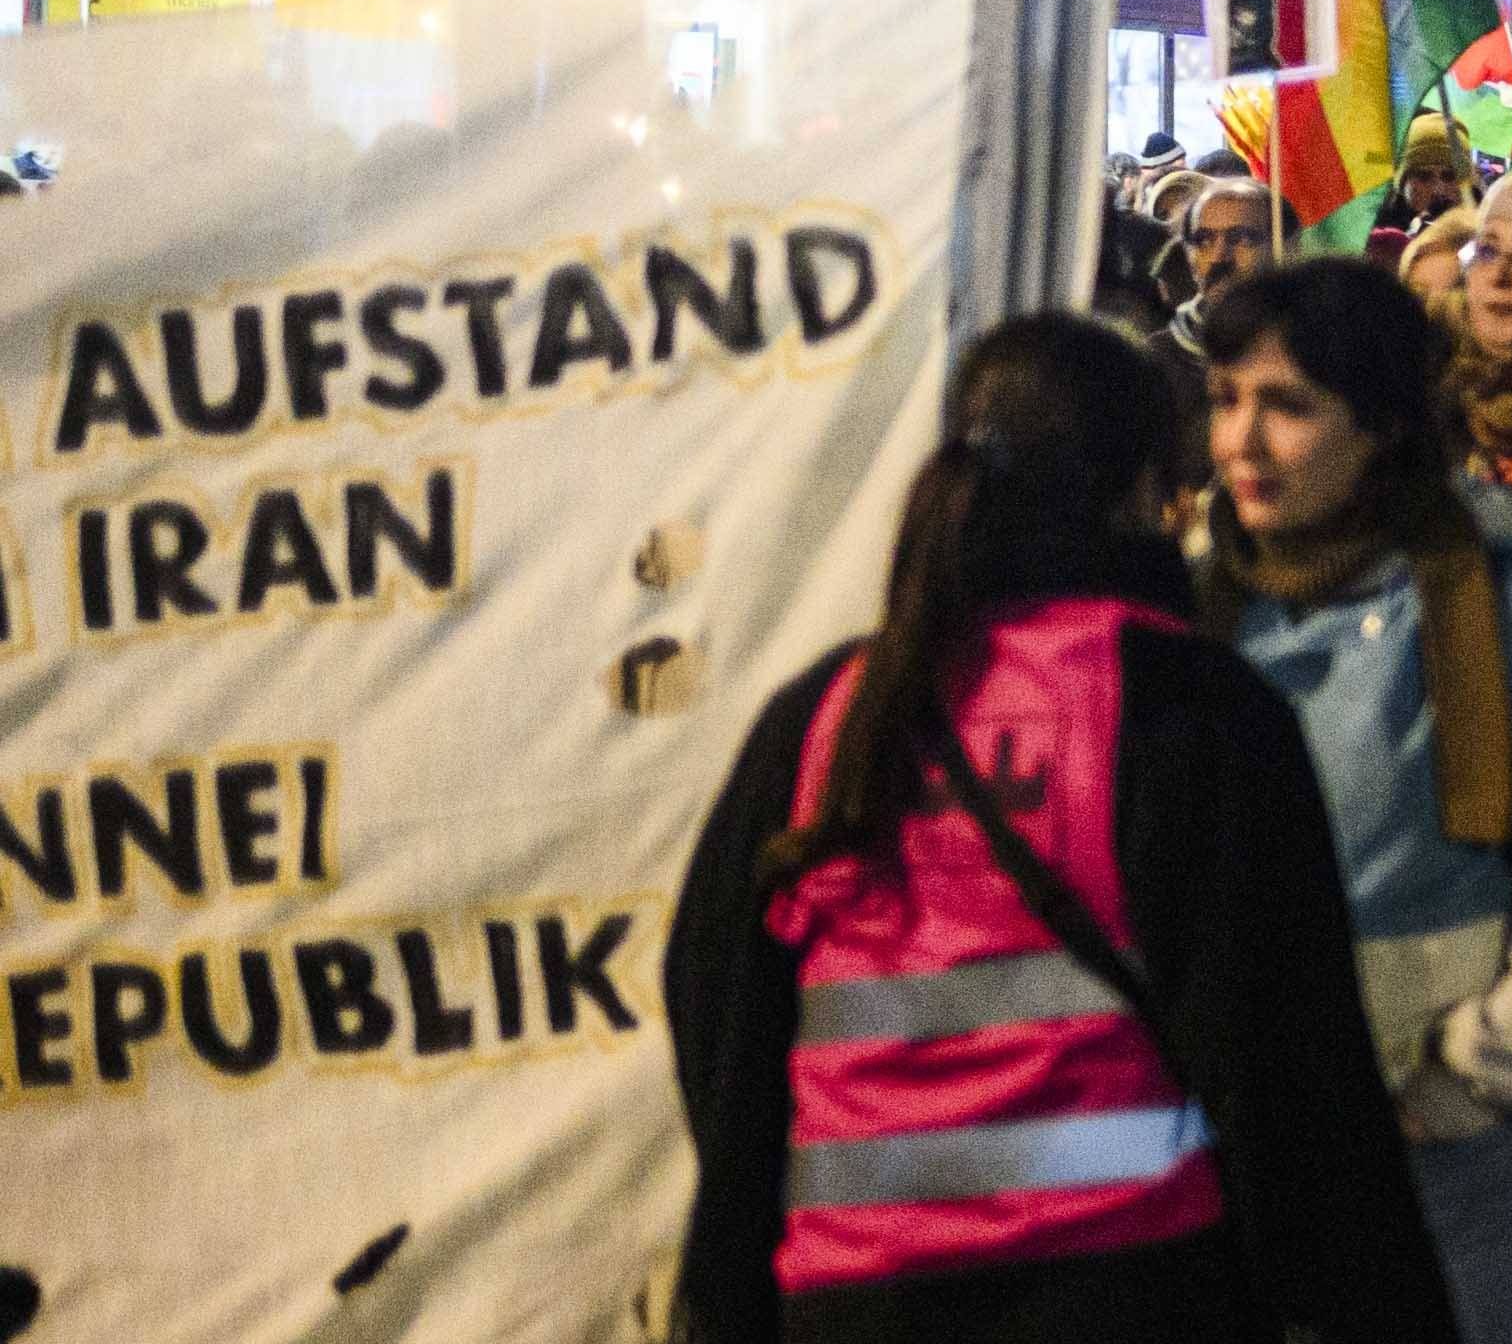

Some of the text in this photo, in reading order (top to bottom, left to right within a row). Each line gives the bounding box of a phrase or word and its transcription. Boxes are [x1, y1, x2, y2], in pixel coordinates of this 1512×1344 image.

[55, 226, 877, 453] AUFSTAND
[77, 469, 456, 631] IRAN
[0, 912, 638, 1090] EPUBLIK
